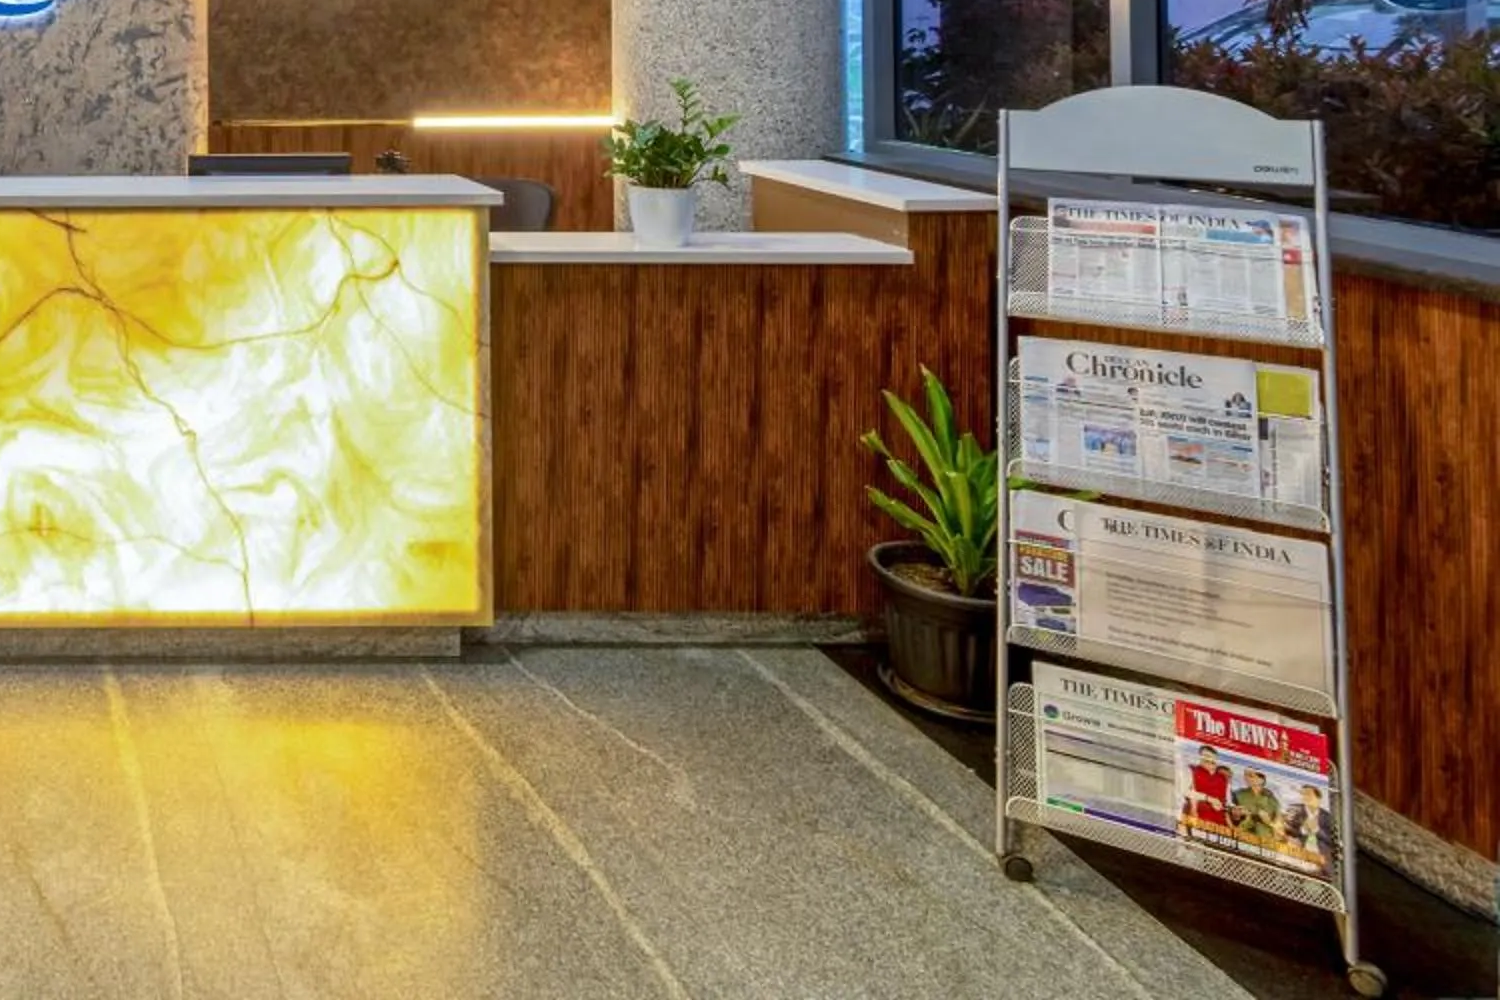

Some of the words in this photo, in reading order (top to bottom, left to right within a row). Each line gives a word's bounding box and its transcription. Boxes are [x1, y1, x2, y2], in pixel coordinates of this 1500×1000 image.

[1067, 207, 1094, 217] THE
[1103, 208, 1157, 222] TIMES
[1188, 214, 1239, 229] INDIA
[1066, 352, 1203, 389] Chronicle
[1142, 525, 1200, 547] TIMES
[1233, 540, 1292, 565] INDIA
[1021, 556, 1068, 582] SALE
[1060, 678, 1098, 698] THE
[1101, 688, 1159, 710] TIMES
[1193, 710, 1225, 736] The
[1229, 719, 1278, 750] NEWS
